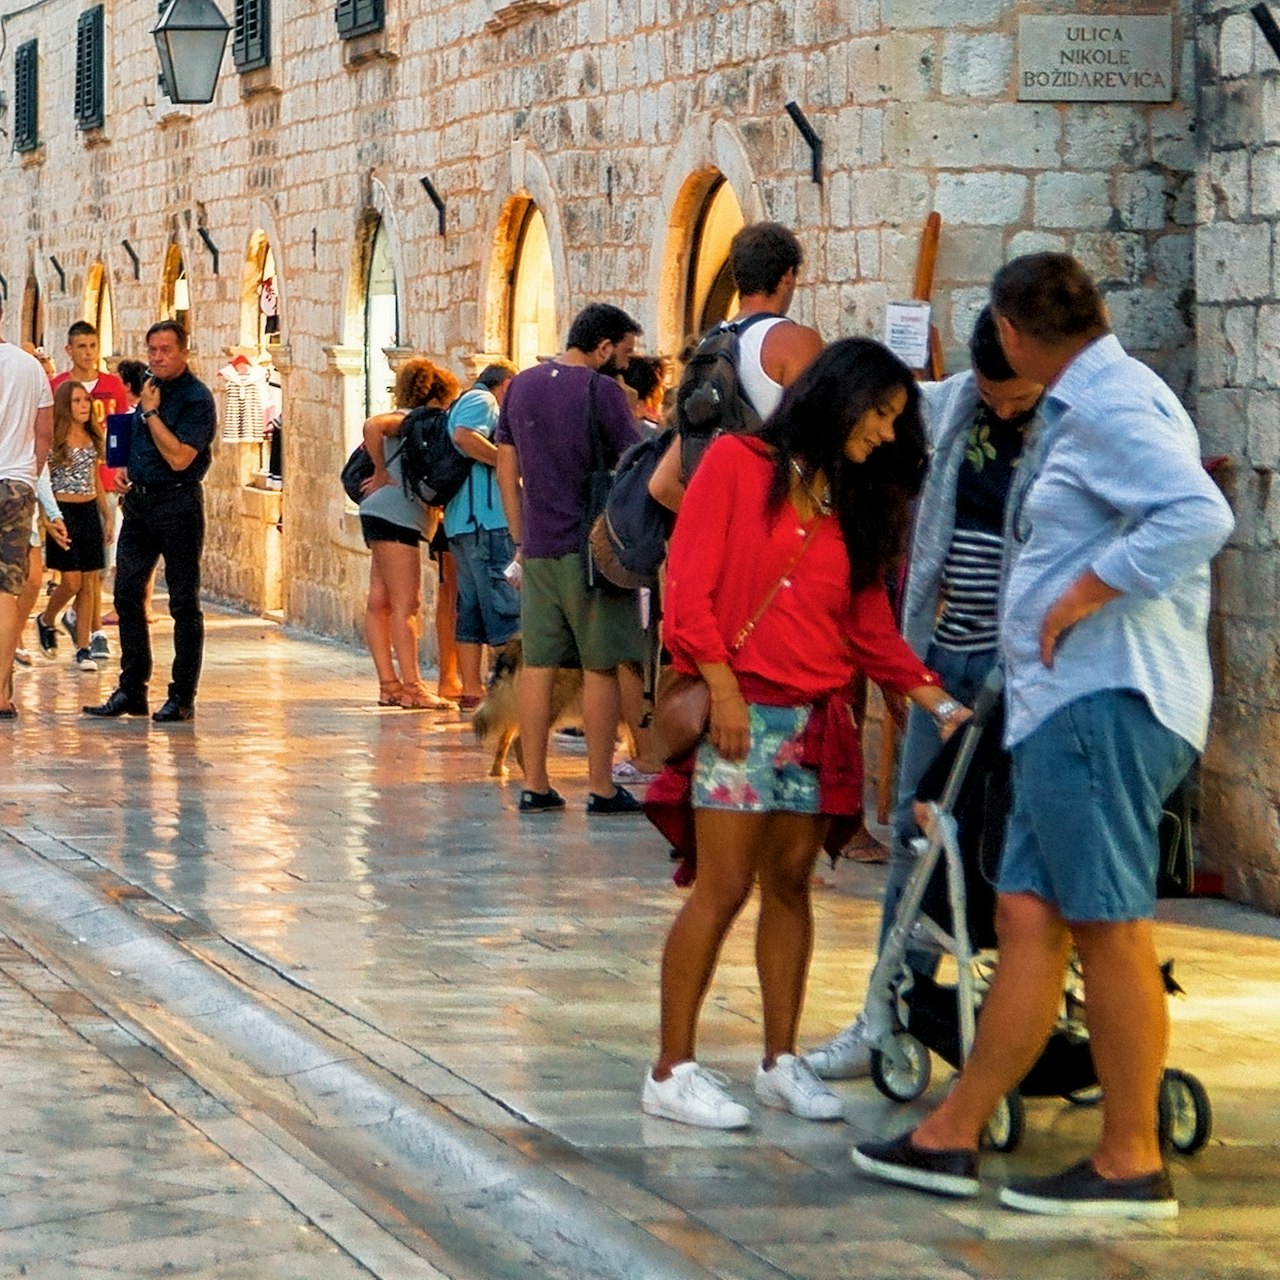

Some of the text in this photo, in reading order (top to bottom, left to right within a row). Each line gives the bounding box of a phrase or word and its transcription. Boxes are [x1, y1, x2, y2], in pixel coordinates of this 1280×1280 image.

[1066, 27, 1123, 42] ULICA
[1060, 49, 1131, 65] NIKOLE
[1024, 68, 1166, 88] BOŽIDAREVIĆA
